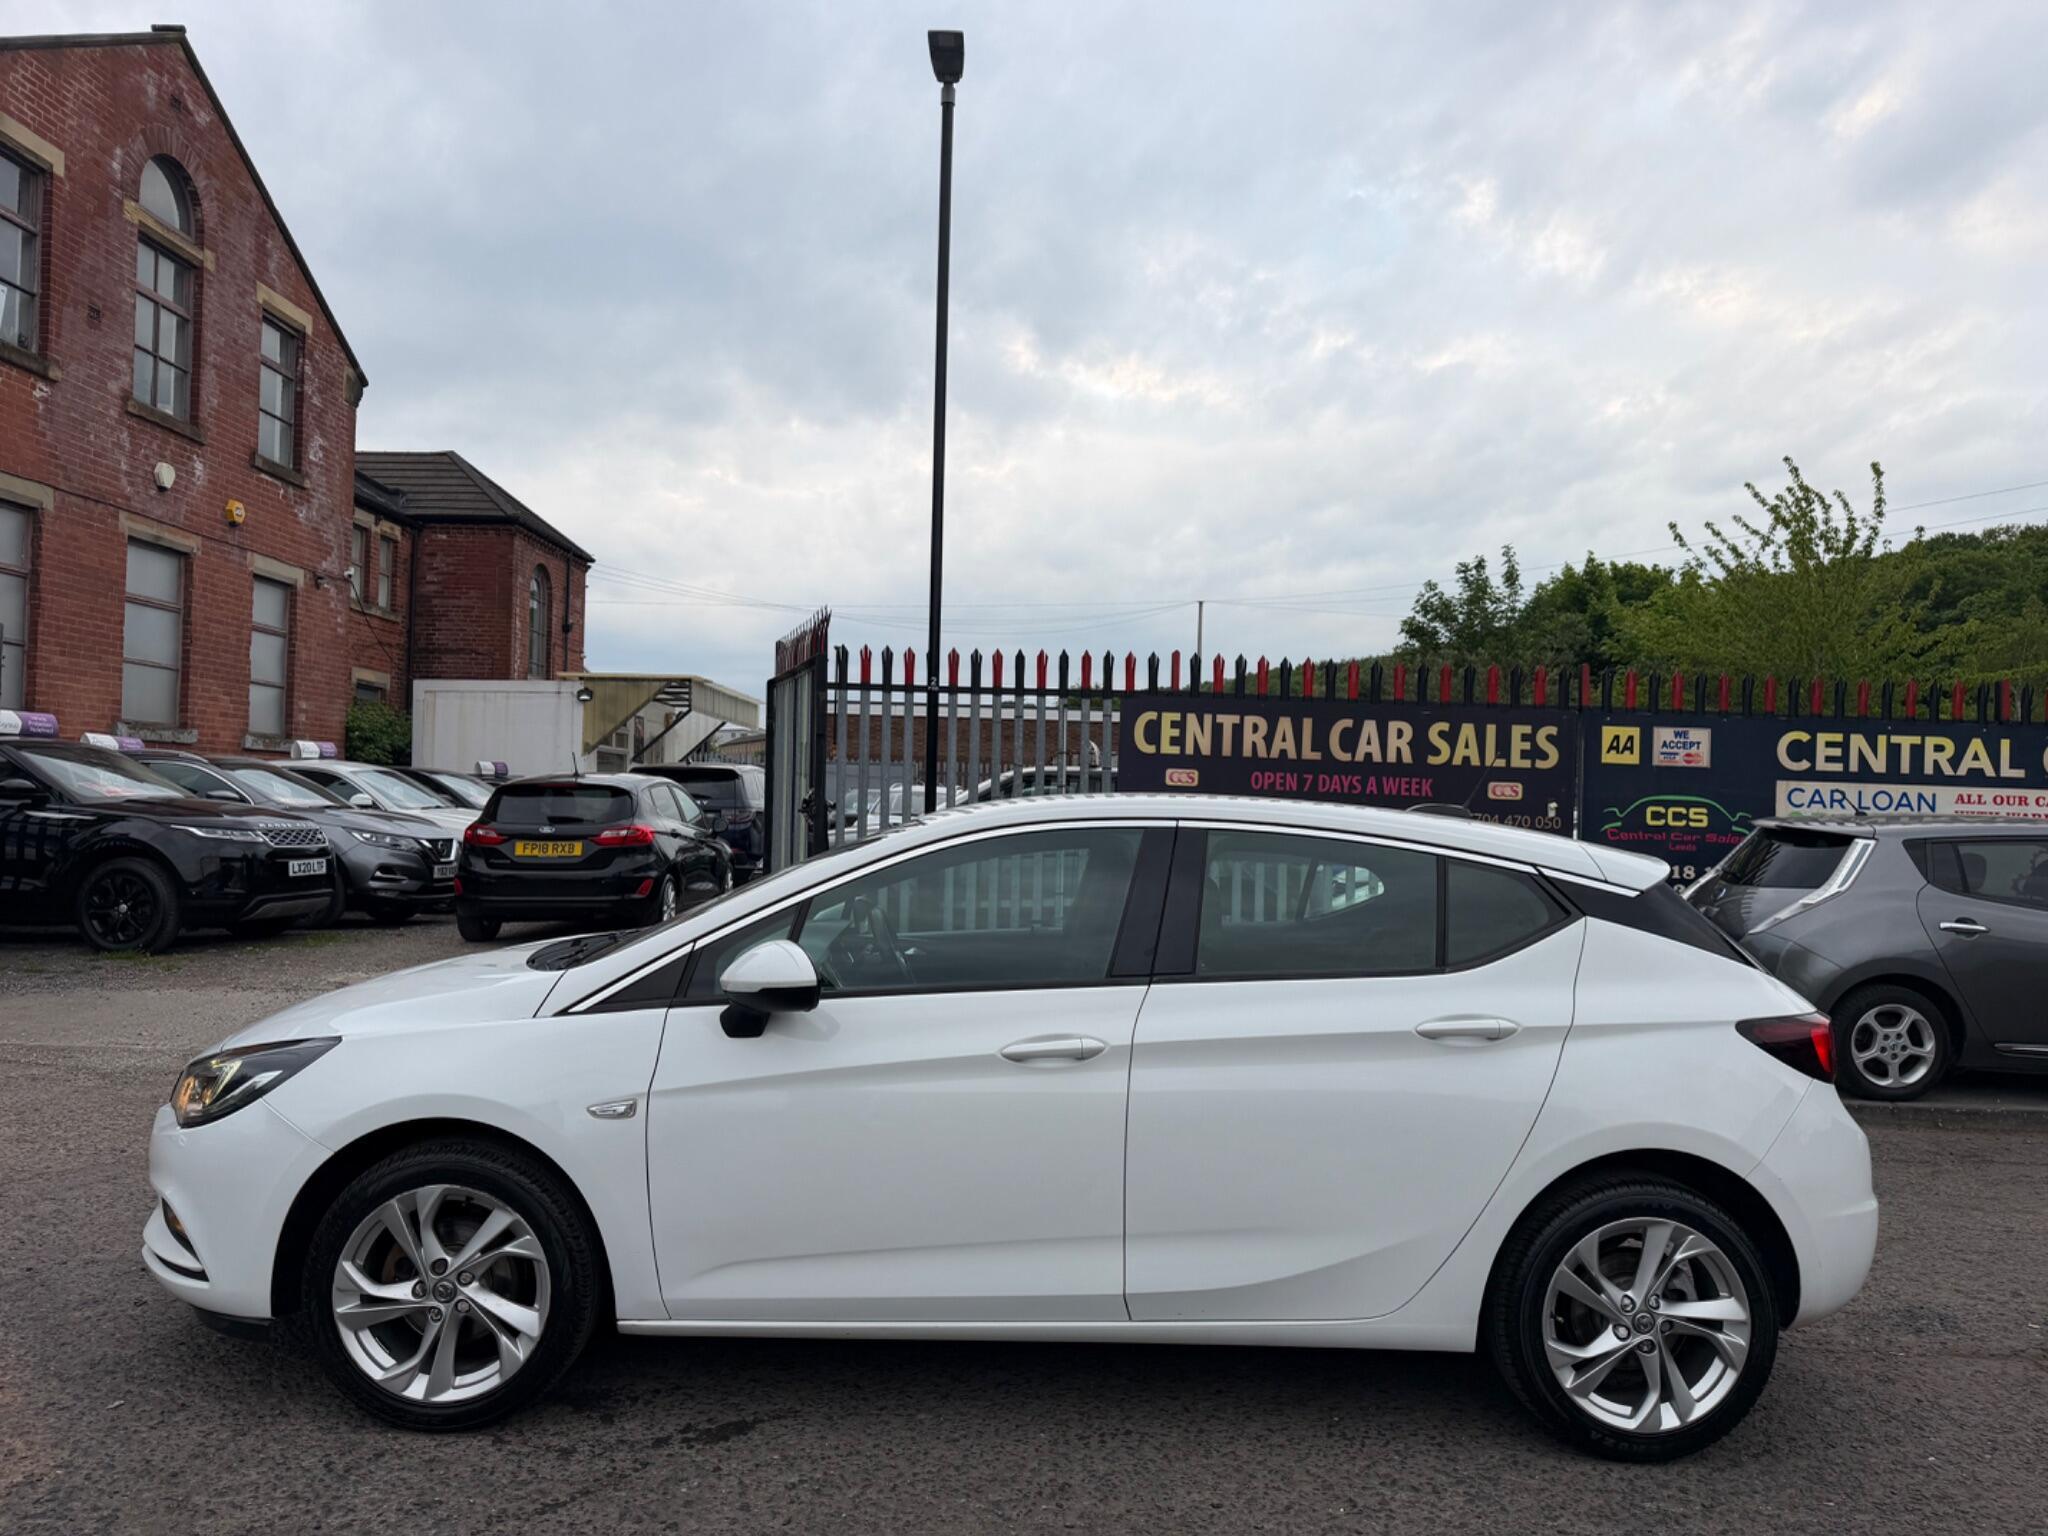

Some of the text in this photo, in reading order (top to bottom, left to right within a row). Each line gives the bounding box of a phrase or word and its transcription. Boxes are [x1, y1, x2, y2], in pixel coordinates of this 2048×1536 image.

[1133, 711, 1560, 769] CENTRAL CAR SALES
[1673, 730, 1690, 740] WE
[1606, 734, 1635, 755] AA
[1660, 740, 1702, 750] ACCEPT
[1776, 730, 2026, 778] CENTRAL
[1250, 771, 1433, 796] OPEN 7 DAYS A WEEK
[1786, 787, 1937, 813] CAR LOAN
[1954, 793, 2048, 808] ALL OUR C
[1504, 815, 1531, 828] 470
[1535, 816, 1562, 829] 050
[1646, 806, 1709, 828] CCS
[1606, 828, 1667, 841] Central
[1670, 832, 1701, 842] Car
[522, 843, 549, 854] FP18
